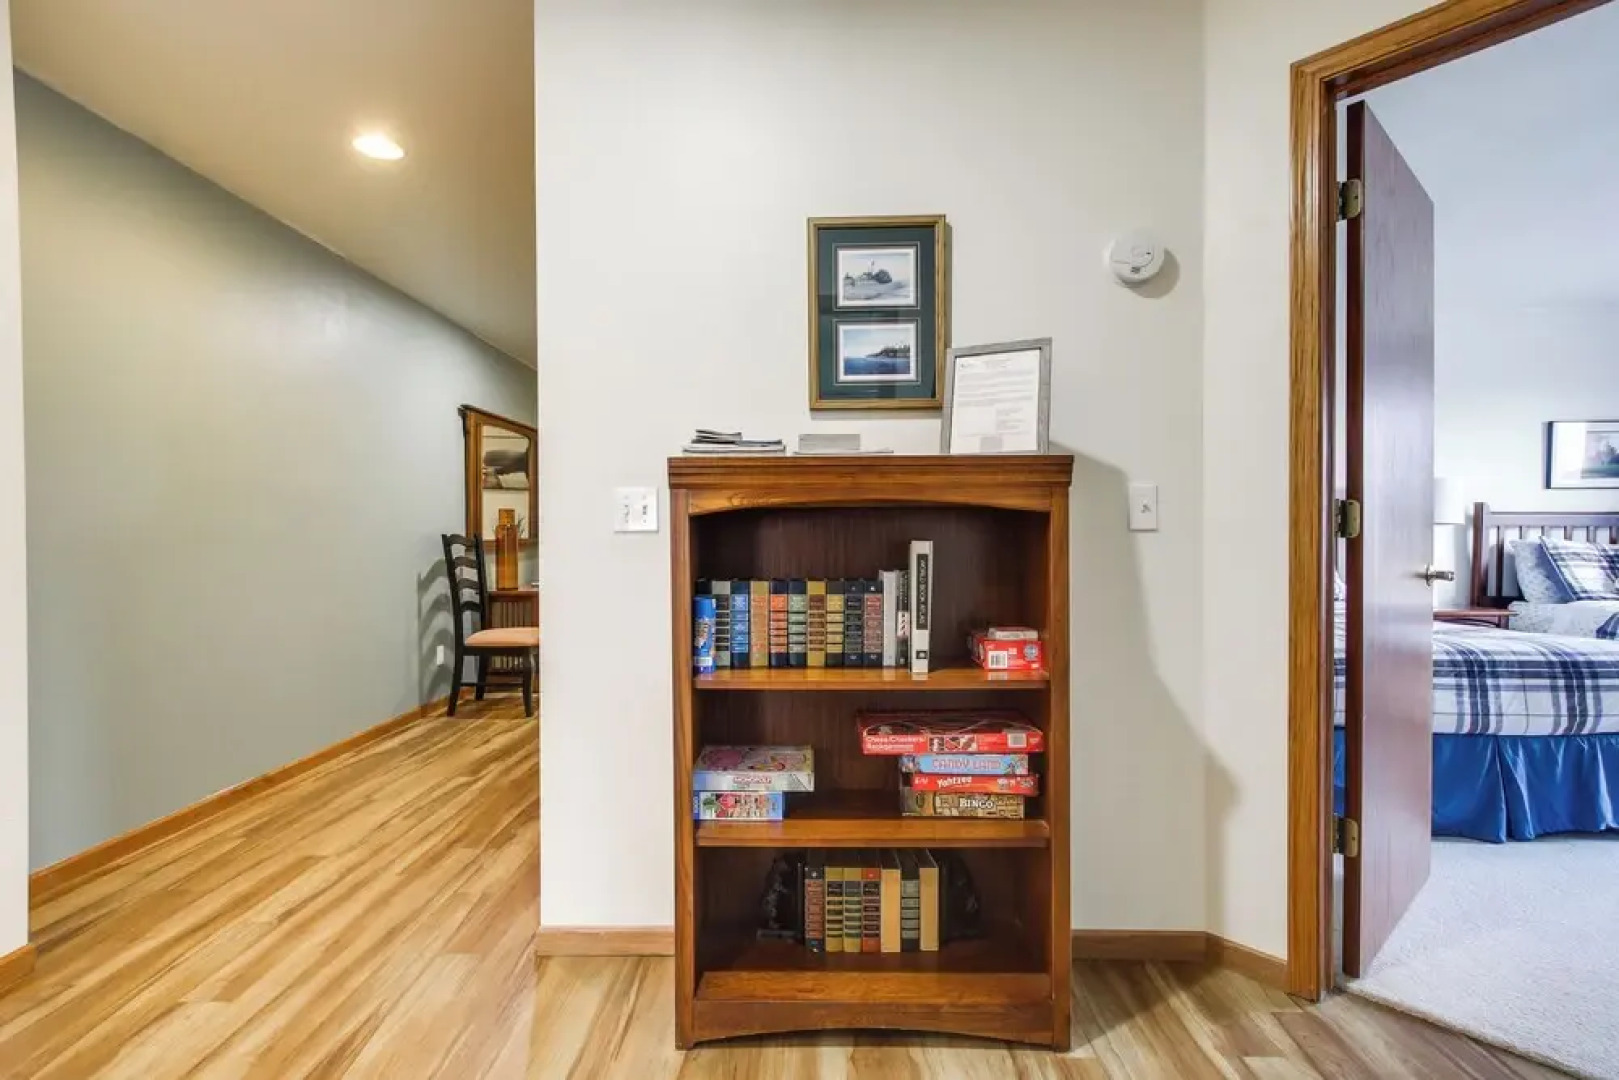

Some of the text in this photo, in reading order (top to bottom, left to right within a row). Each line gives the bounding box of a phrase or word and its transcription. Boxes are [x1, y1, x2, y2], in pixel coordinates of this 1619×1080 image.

[919, 559, 927, 624] WORLD BOOK ATLAS
[960, 797, 993, 809] BINGO
